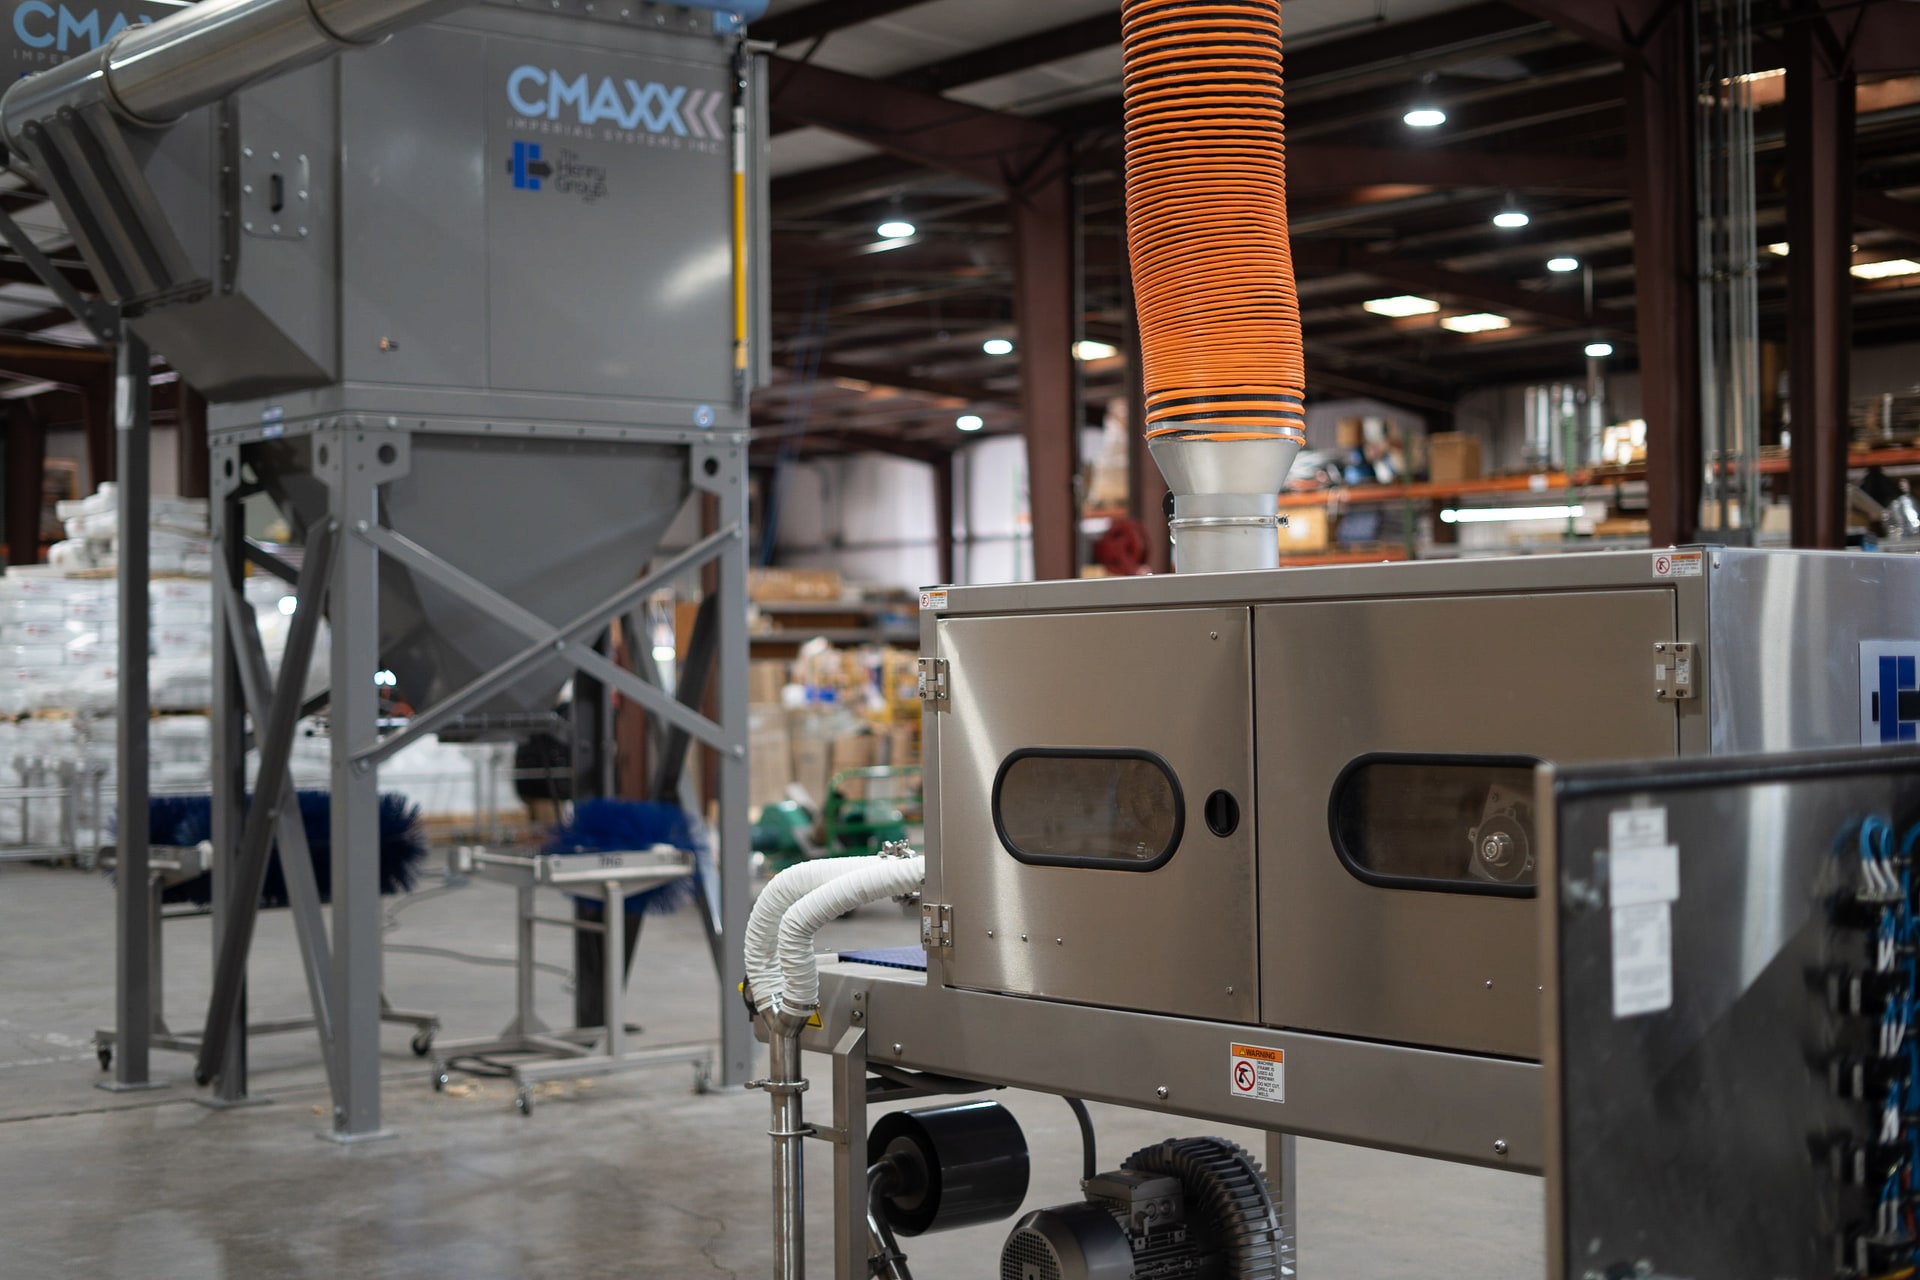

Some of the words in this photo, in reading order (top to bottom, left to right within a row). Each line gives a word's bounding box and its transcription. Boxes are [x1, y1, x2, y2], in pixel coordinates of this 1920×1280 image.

[13, 0, 152, 52] CMA
[506, 64, 689, 137] CMAXX
[1245, 1048, 1275, 1060] WARNING
